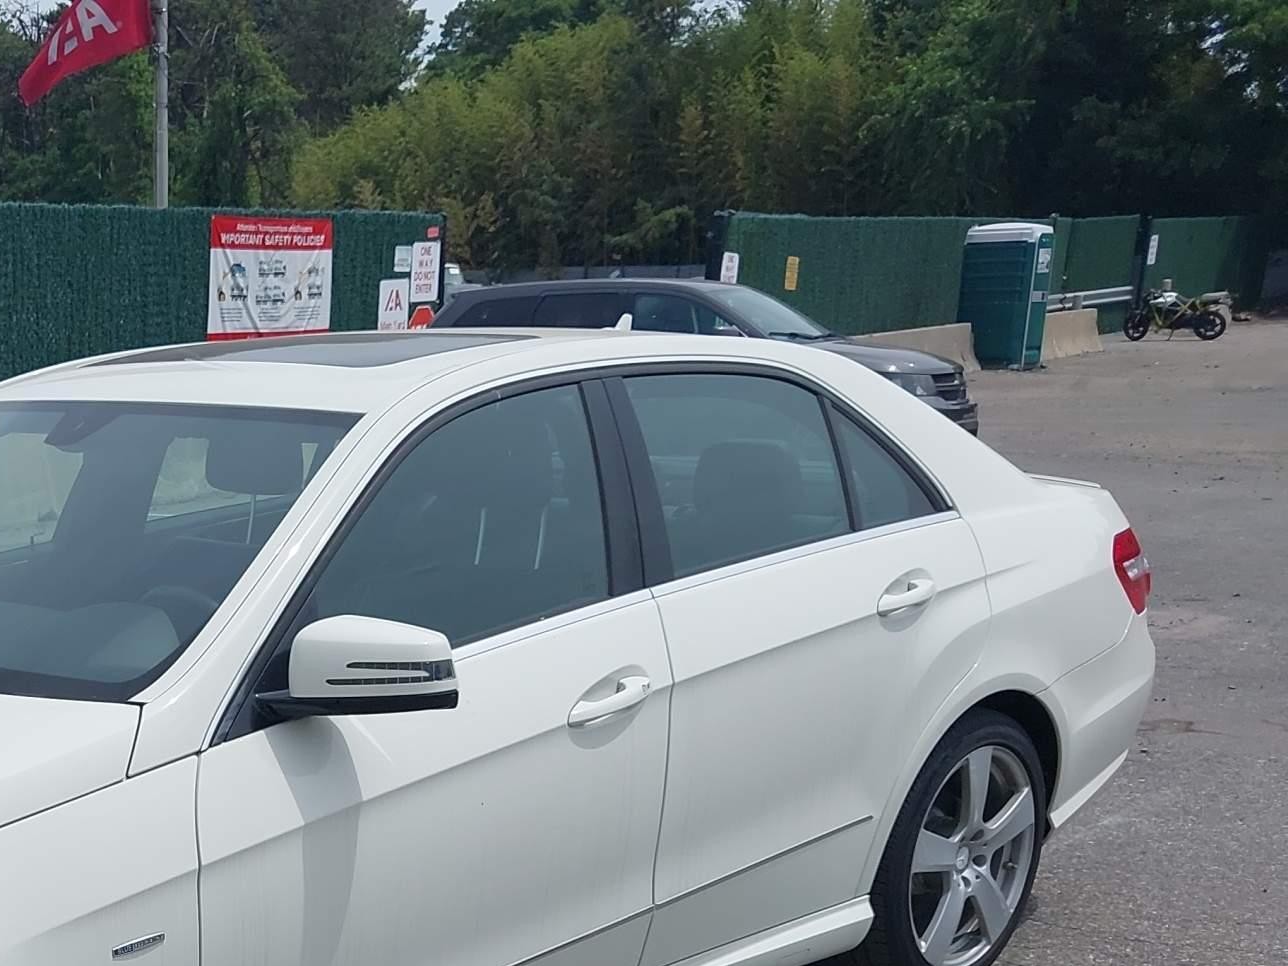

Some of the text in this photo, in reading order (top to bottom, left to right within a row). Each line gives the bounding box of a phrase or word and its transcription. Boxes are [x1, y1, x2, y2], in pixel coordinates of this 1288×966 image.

[220, 233, 325, 246] IMPORTANT SAFETY POLICIES
[420, 246, 432, 256] ONE
[418, 259, 434, 267] WAY
[413, 271, 436, 281] DO NOT
[415, 283, 432, 294] ENTER
